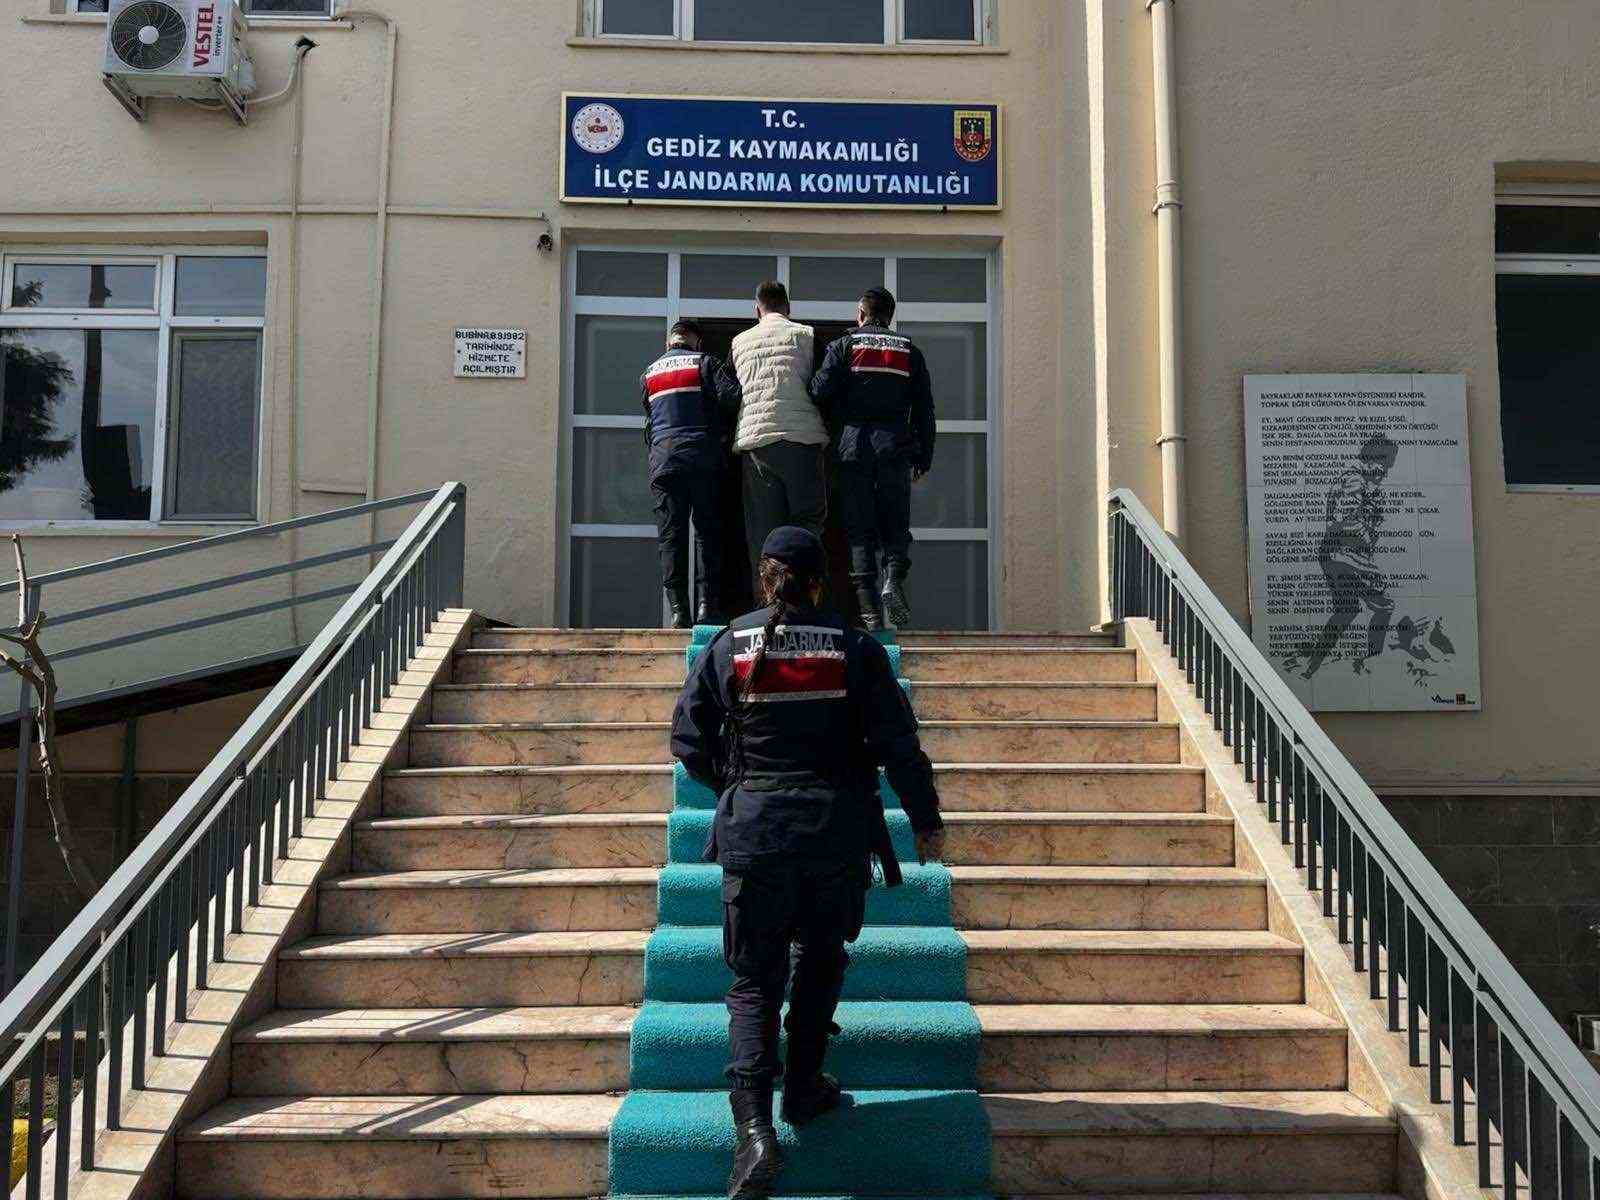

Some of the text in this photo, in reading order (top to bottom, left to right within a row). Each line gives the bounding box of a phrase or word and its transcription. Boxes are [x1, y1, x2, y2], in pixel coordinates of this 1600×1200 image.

[193, 3, 214, 67] VESTEL
[761, 109, 805, 128] T.C.
[647, 134, 919, 162] GEDİZ KAYMAKAMLIĞI
[595, 164, 970, 195] İLÇE JANDARMA KOMUTANLIĞI
[465, 342, 515, 351] TARİHİNDE
[469, 353, 509, 362] HİZMETE
[744, 631, 836, 653] JADARMA
